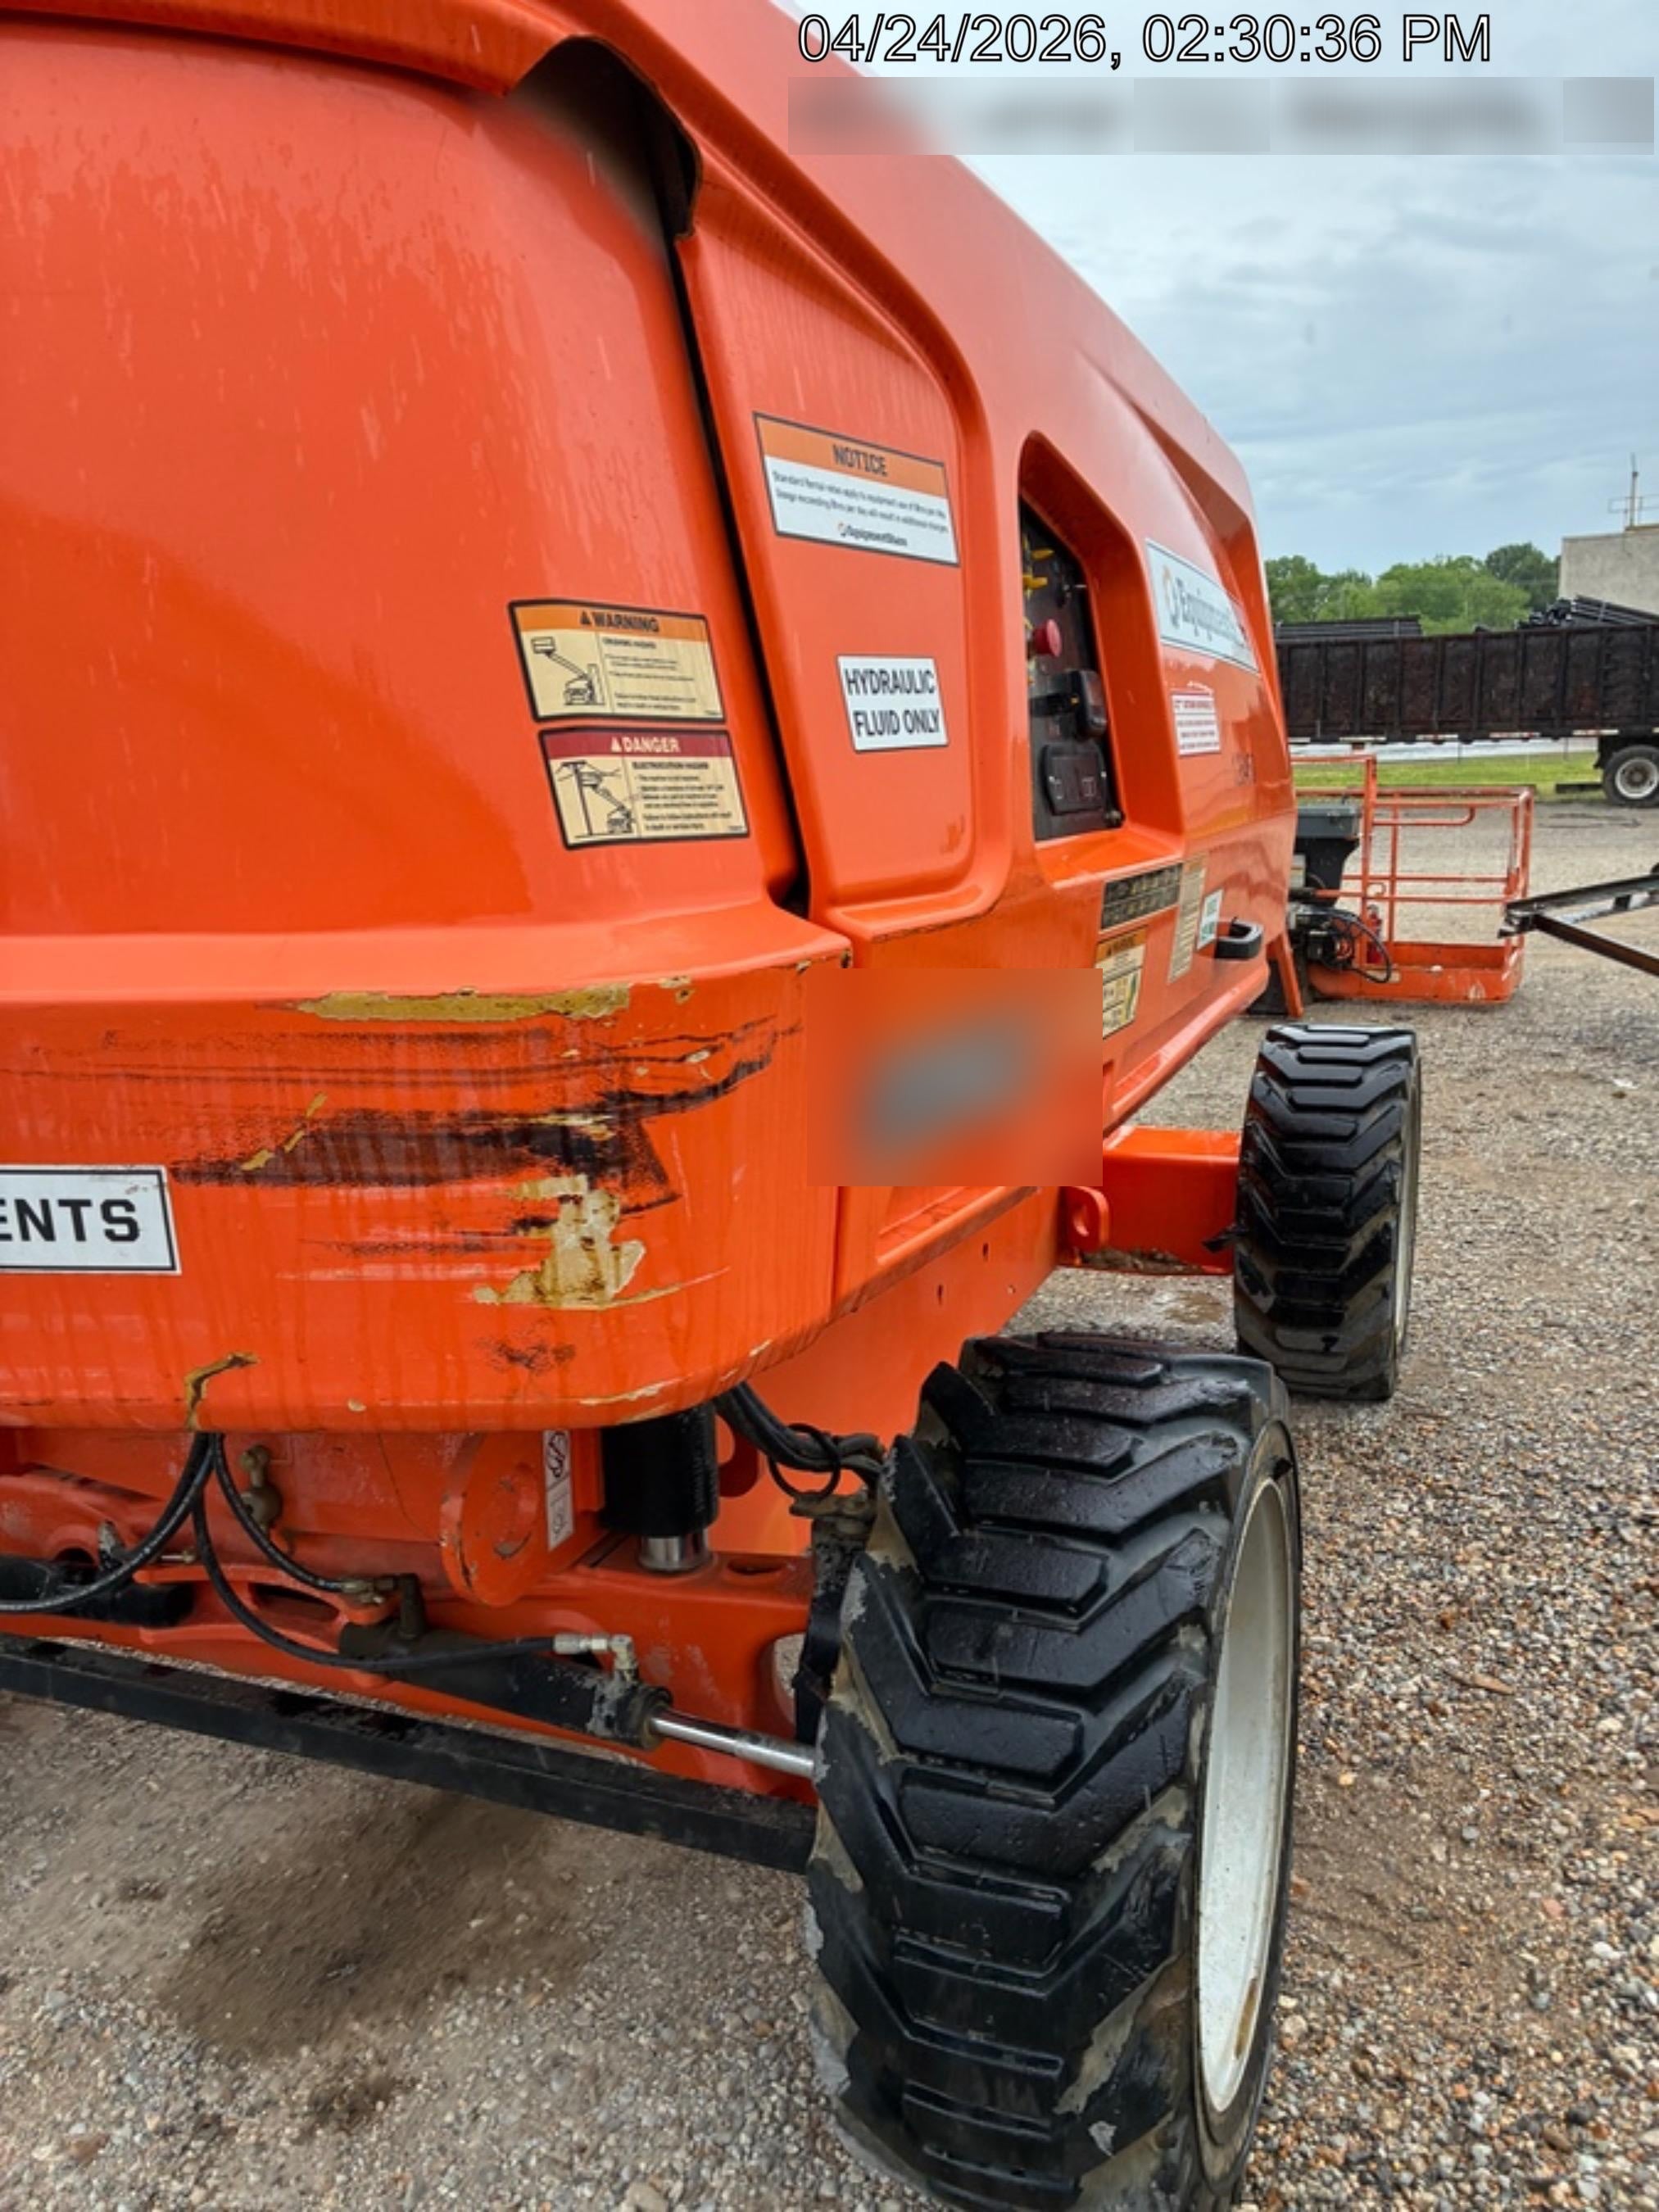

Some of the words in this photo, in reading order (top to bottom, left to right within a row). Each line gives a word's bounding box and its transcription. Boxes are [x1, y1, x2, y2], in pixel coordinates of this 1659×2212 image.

[832, 444, 887, 477] NOTICE
[591, 611, 660, 632] WARNING
[844, 668, 936, 696] HYDRAULIC
[853, 709, 900, 737] FLUID
[902, 709, 940, 735] ONLY
[623, 736, 682, 753] DANGER
